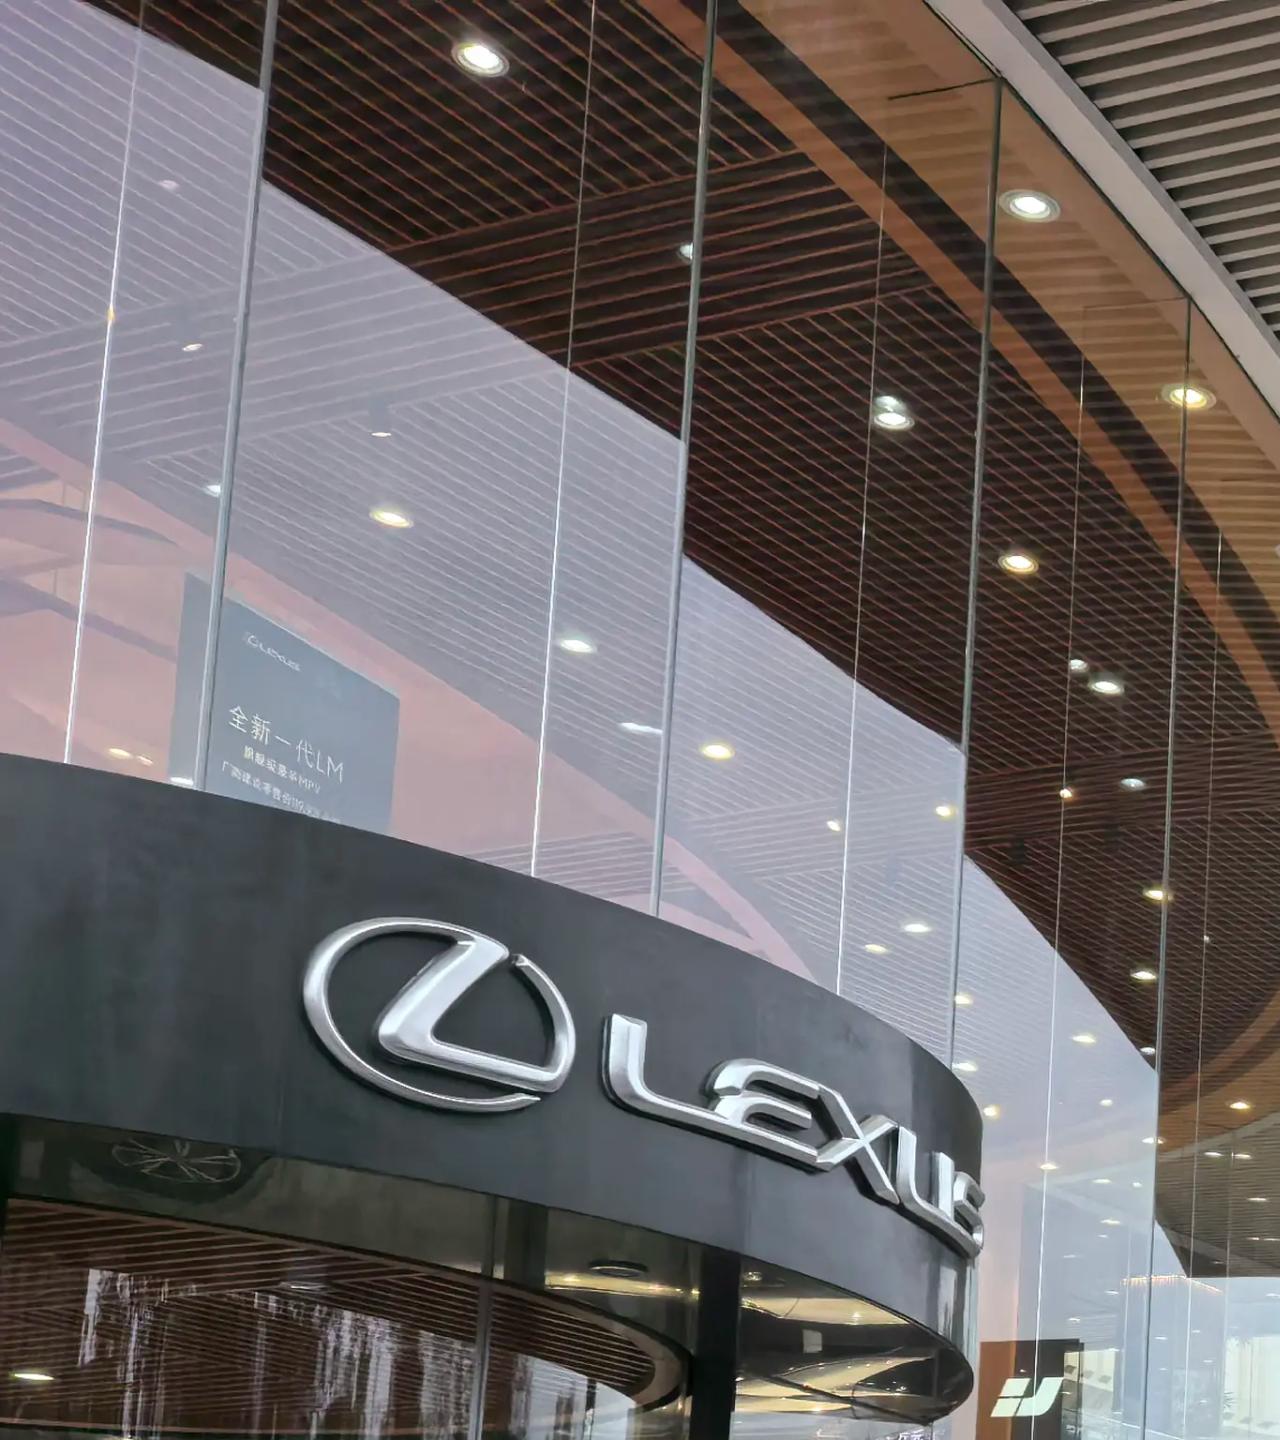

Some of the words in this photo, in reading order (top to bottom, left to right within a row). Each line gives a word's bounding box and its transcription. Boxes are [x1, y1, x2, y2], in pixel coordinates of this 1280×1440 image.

[228, 705, 344, 784] 全新一代LM
[600, 1012, 986, 1259] LEXUS
